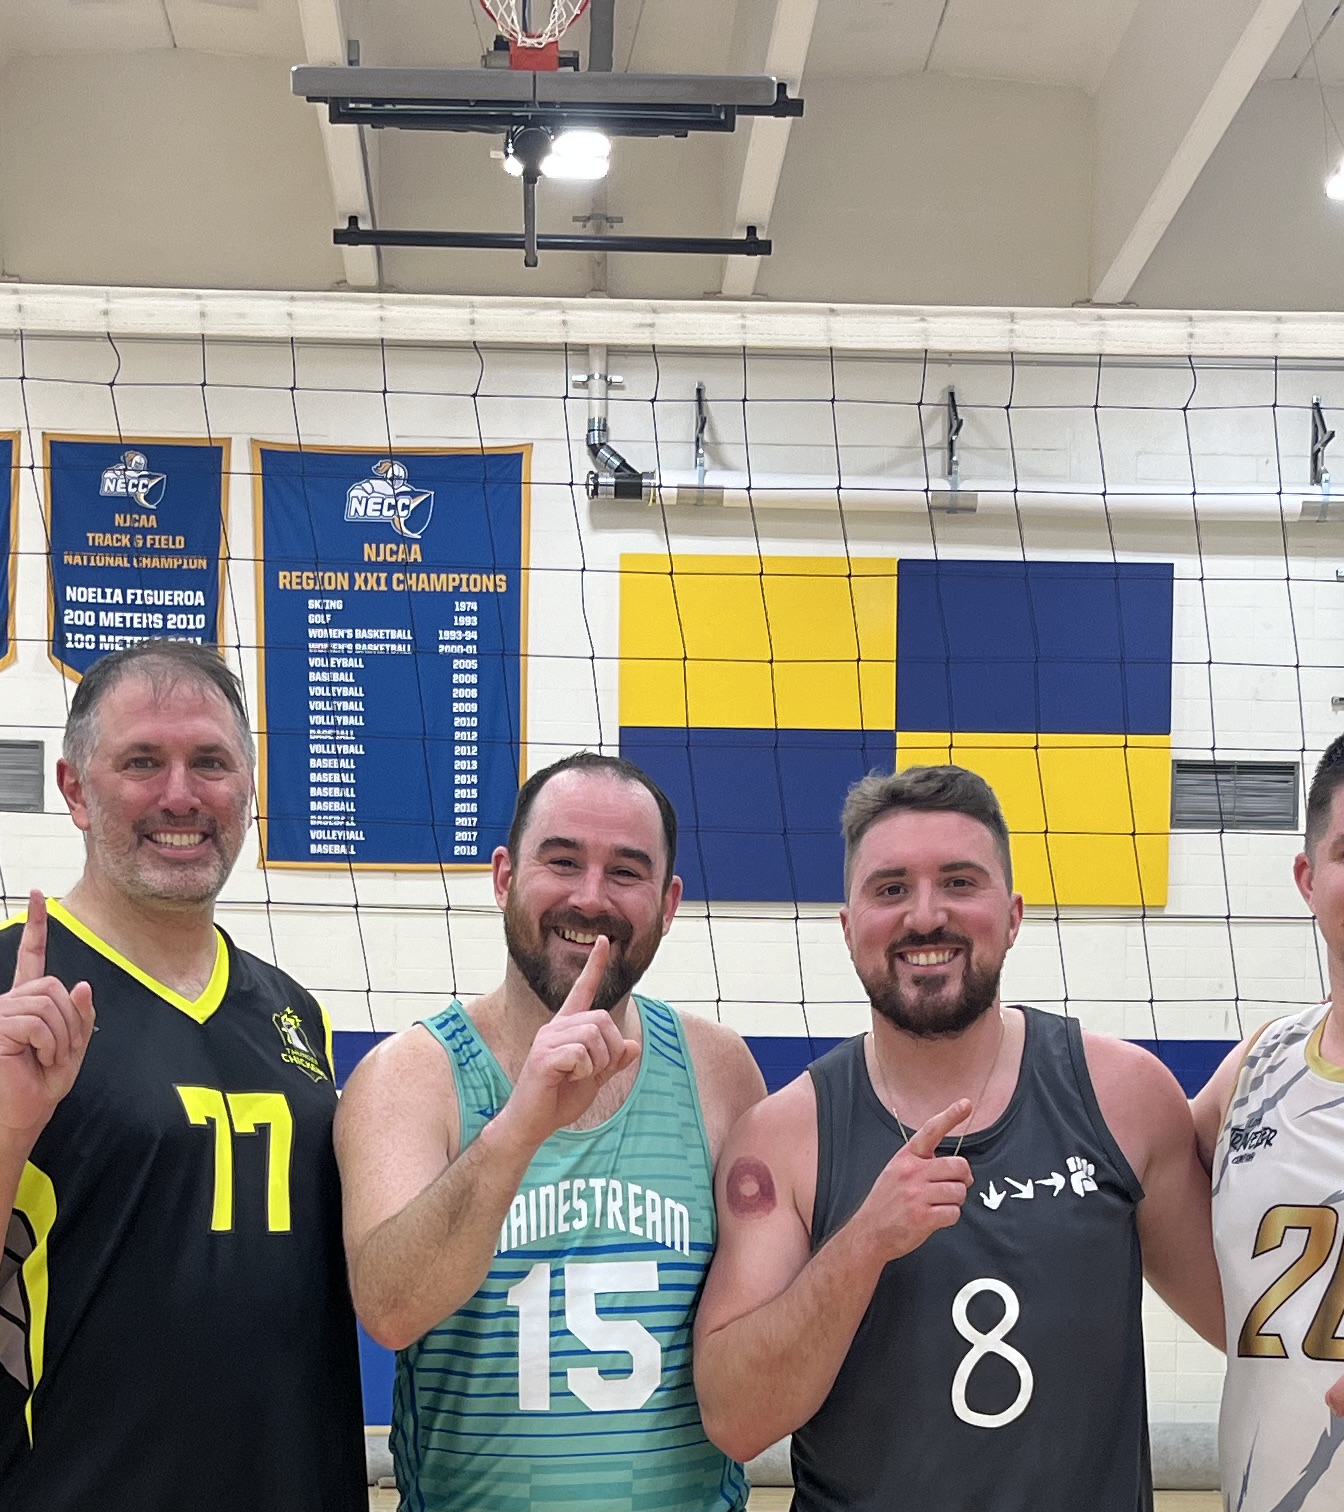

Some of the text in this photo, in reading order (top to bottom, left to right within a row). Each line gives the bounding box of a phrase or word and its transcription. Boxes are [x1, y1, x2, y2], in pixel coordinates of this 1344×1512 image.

[103, 477, 148, 493] NECC
[350, 495, 410, 517] NECC
[115, 514, 157, 528] NJCAA
[87, 533, 130, 547] TRACK
[147, 535, 184, 548] FIELD
[364, 544, 422, 562] NJCAA
[64, 551, 207, 570] NATIONAL CHAMPION
[279, 571, 506, 592] REGION XXI CHAMPIONS
[66, 586, 205, 606] NOELIA FIGUEROA
[308, 599, 477, 611] SKIING 1974
[64, 609, 205, 629] 200 METERS 2010
[308, 614, 477, 626] GOLF 1993
[308, 629, 353, 639] WOMEN'S
[356, 629, 412, 639] BASKETBALL
[66, 633, 95, 649] 100
[99, 635, 159, 650] MET
[453, 659, 477, 669] 2005
[309, 686, 364, 696] VOLLEYBALL
[453, 703, 477, 712] 2009
[454, 717, 477, 727] 2010
[455, 731, 477, 741] 2012
[309, 744, 477, 755] VOLLEYBALL 2012
[310, 758, 477, 770] BASEBALL 2013
[310, 773, 477, 784] BASEBALL 2014
[310, 787, 477, 798] BASEBALL 2015
[310, 801, 477, 812] BASEBALL 2016
[455, 817, 477, 826] 2017
[310, 830, 477, 841] VOLLEYBALL 2017
[454, 846, 477, 855] 2018
[176, 1086, 292, 1231] 77
[507, 1260, 661, 1411] 15
[952, 1278, 1034, 1428] 8
